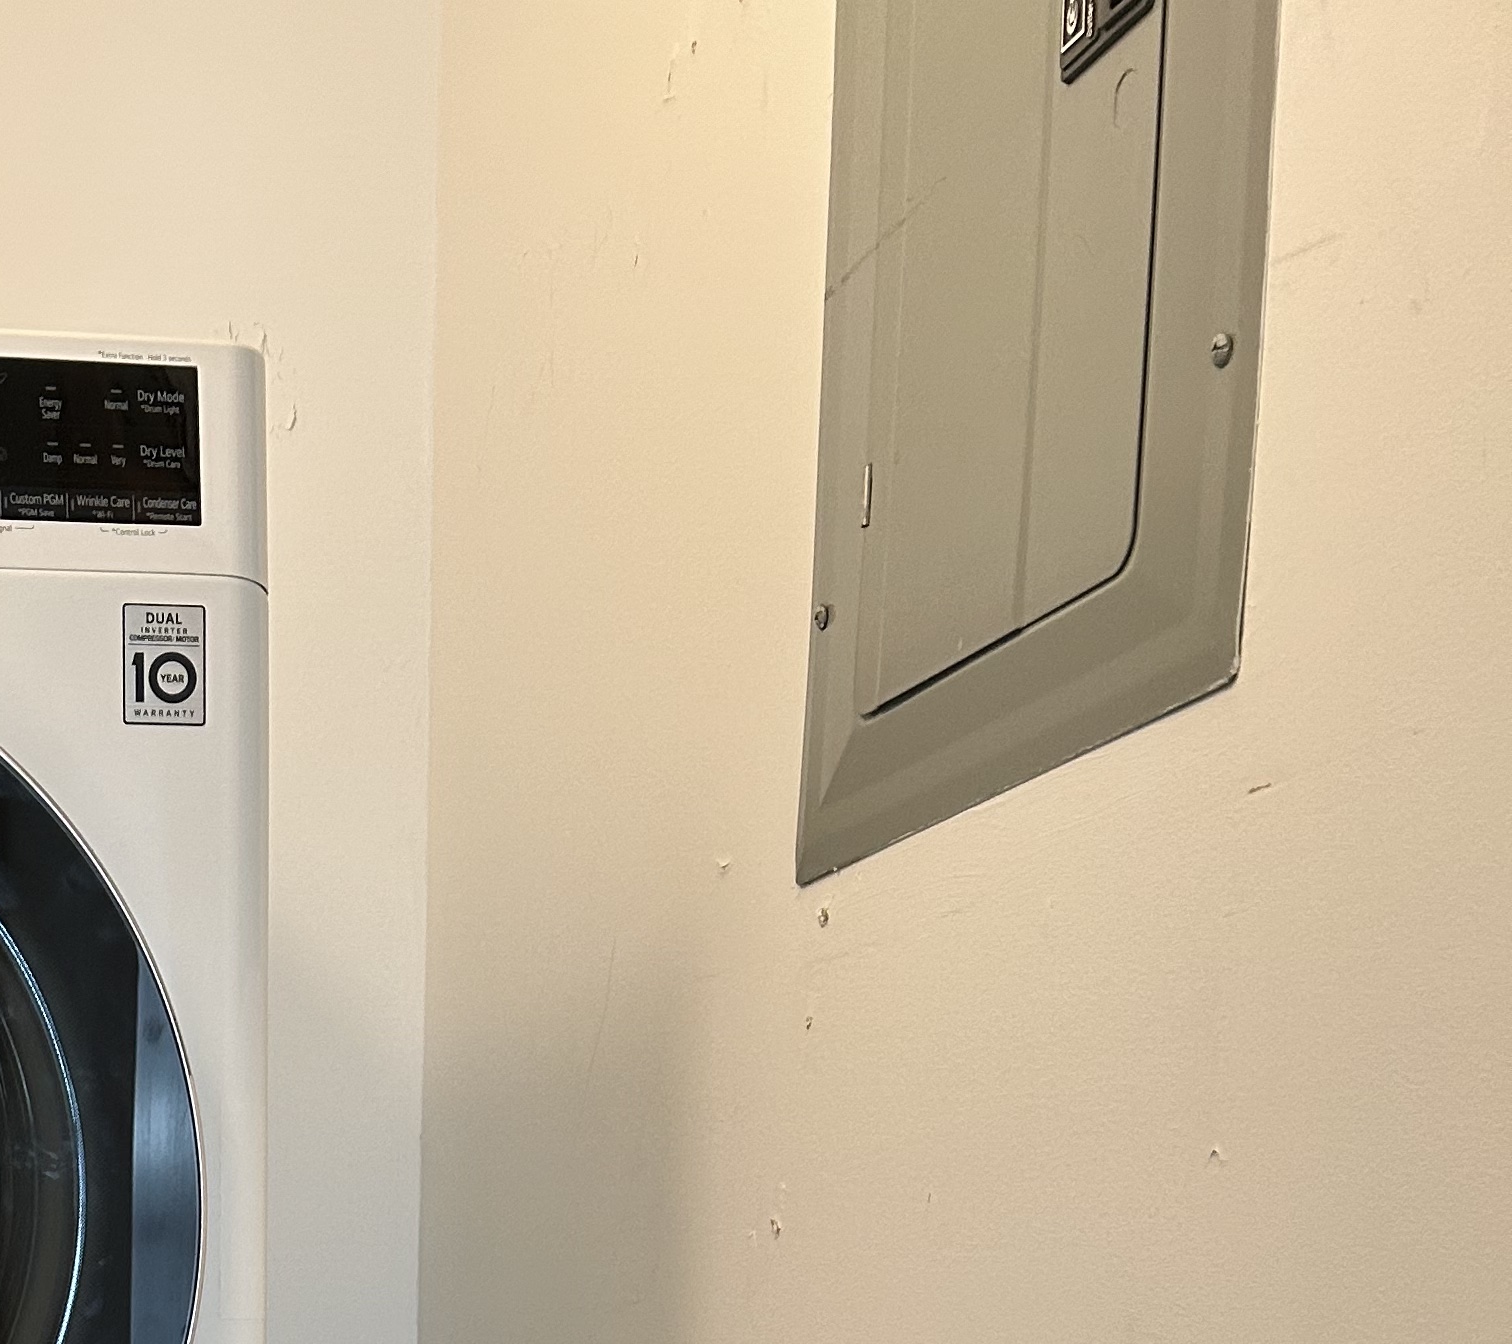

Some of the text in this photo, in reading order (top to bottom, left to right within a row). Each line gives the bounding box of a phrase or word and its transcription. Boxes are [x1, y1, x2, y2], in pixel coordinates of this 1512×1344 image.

[39, 396, 63, 410] Energy
[138, 390, 185, 404] Dry Mode
[104, 400, 128, 411] Normal
[42, 408, 61, 420] Saver
[42, 452, 63, 465] Damp
[140, 445, 186, 459] Dry Level
[73, 454, 98, 465] Normal
[111, 455, 126, 467] Very
[10, 492, 64, 506] Custom PGM
[76, 494, 131, 508] Wrinkle Care
[181, 498, 198, 510] Care
[145, 611, 182, 625] DUAL
[131, 651, 197, 704] 10 YEAR
[133, 709, 195, 718] WARRANTY
